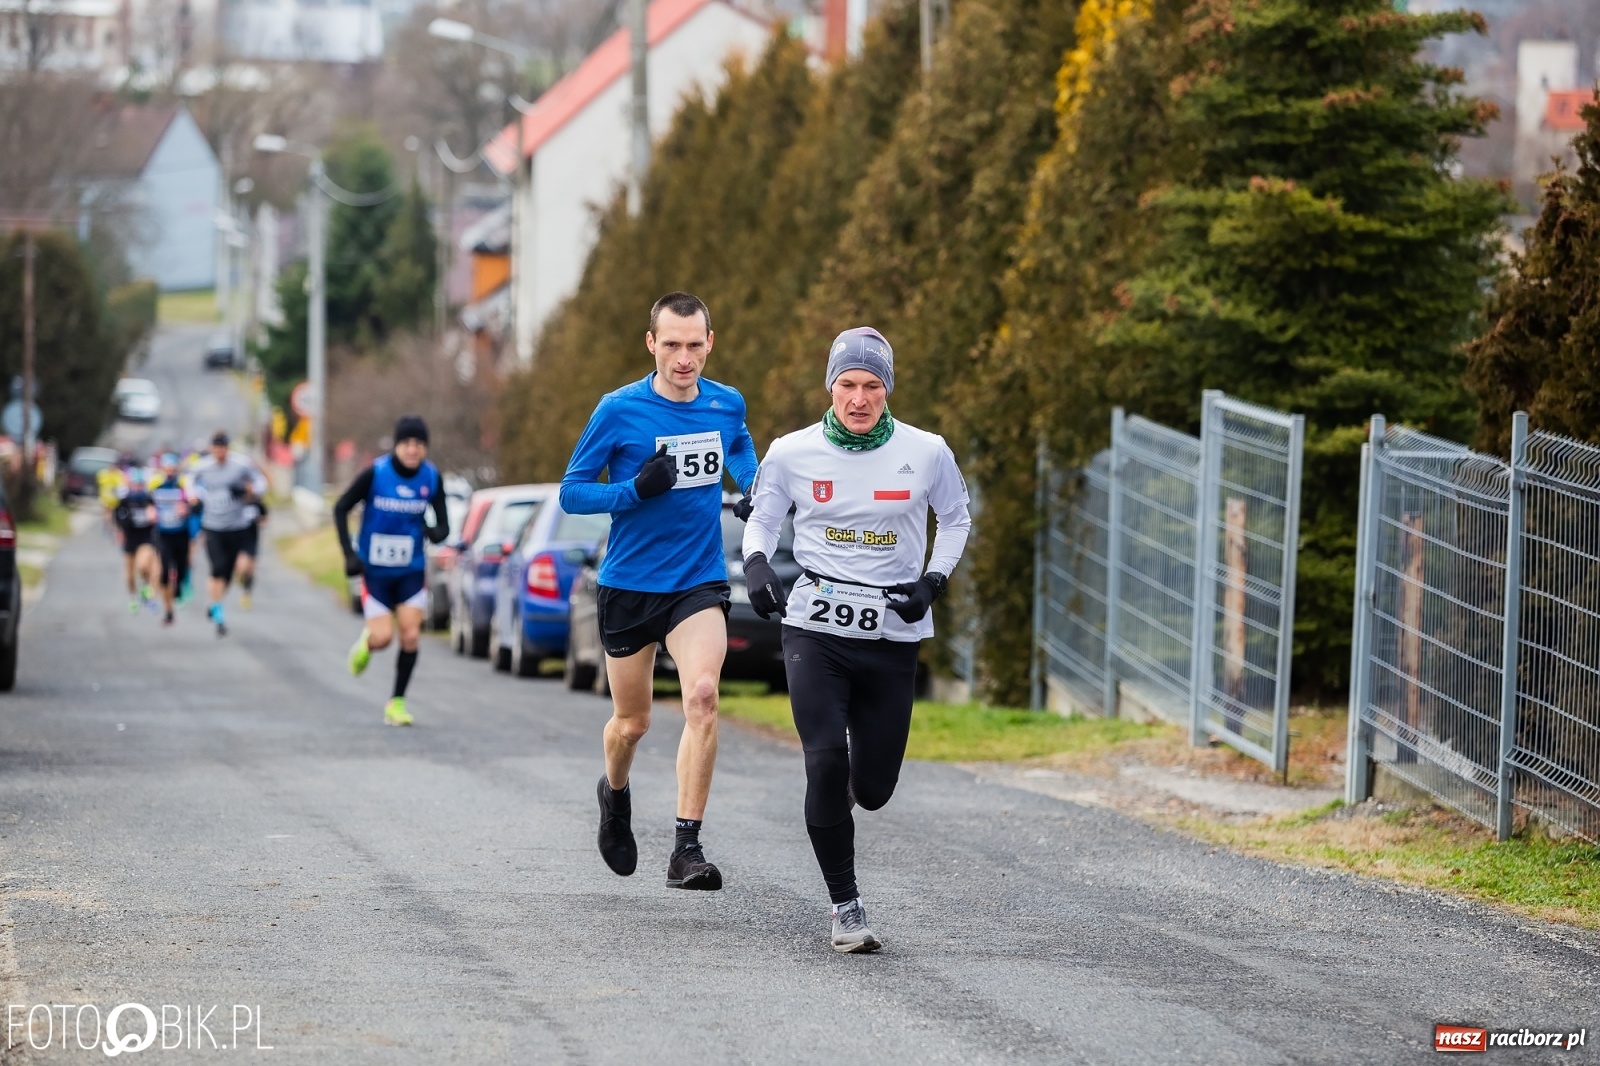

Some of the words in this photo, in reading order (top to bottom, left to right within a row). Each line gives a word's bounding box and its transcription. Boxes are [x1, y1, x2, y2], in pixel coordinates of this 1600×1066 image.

[826, 527, 856, 542] Gold
[863, 530, 897, 545] Bruk
[837, 589, 884, 600] www.personalbest.pl
[809, 599, 878, 631] 298
